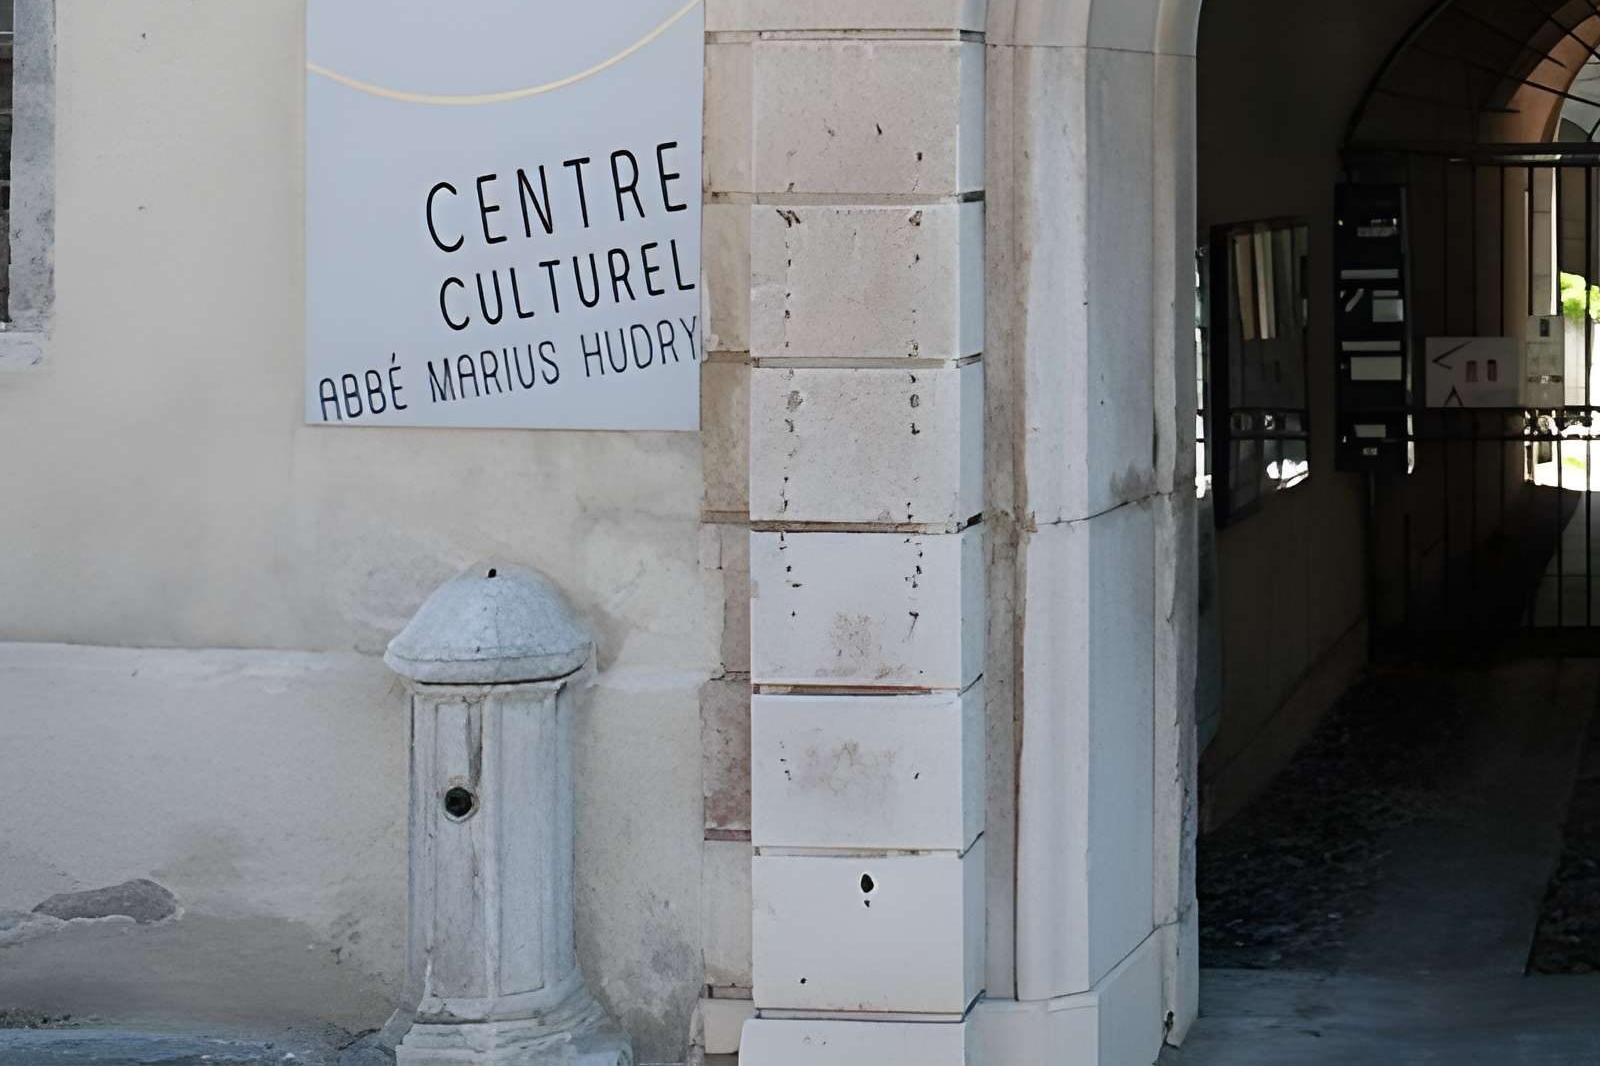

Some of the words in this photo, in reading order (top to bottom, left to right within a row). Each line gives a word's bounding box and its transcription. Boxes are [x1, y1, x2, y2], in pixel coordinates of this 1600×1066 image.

[426, 141, 687, 253] CENTRE
[440, 239, 695, 331] CULTUREL
[319, 352, 408, 422] ABBÉ
[428, 341, 560, 403] MARIUS
[580, 316, 698, 378] HUDRY
